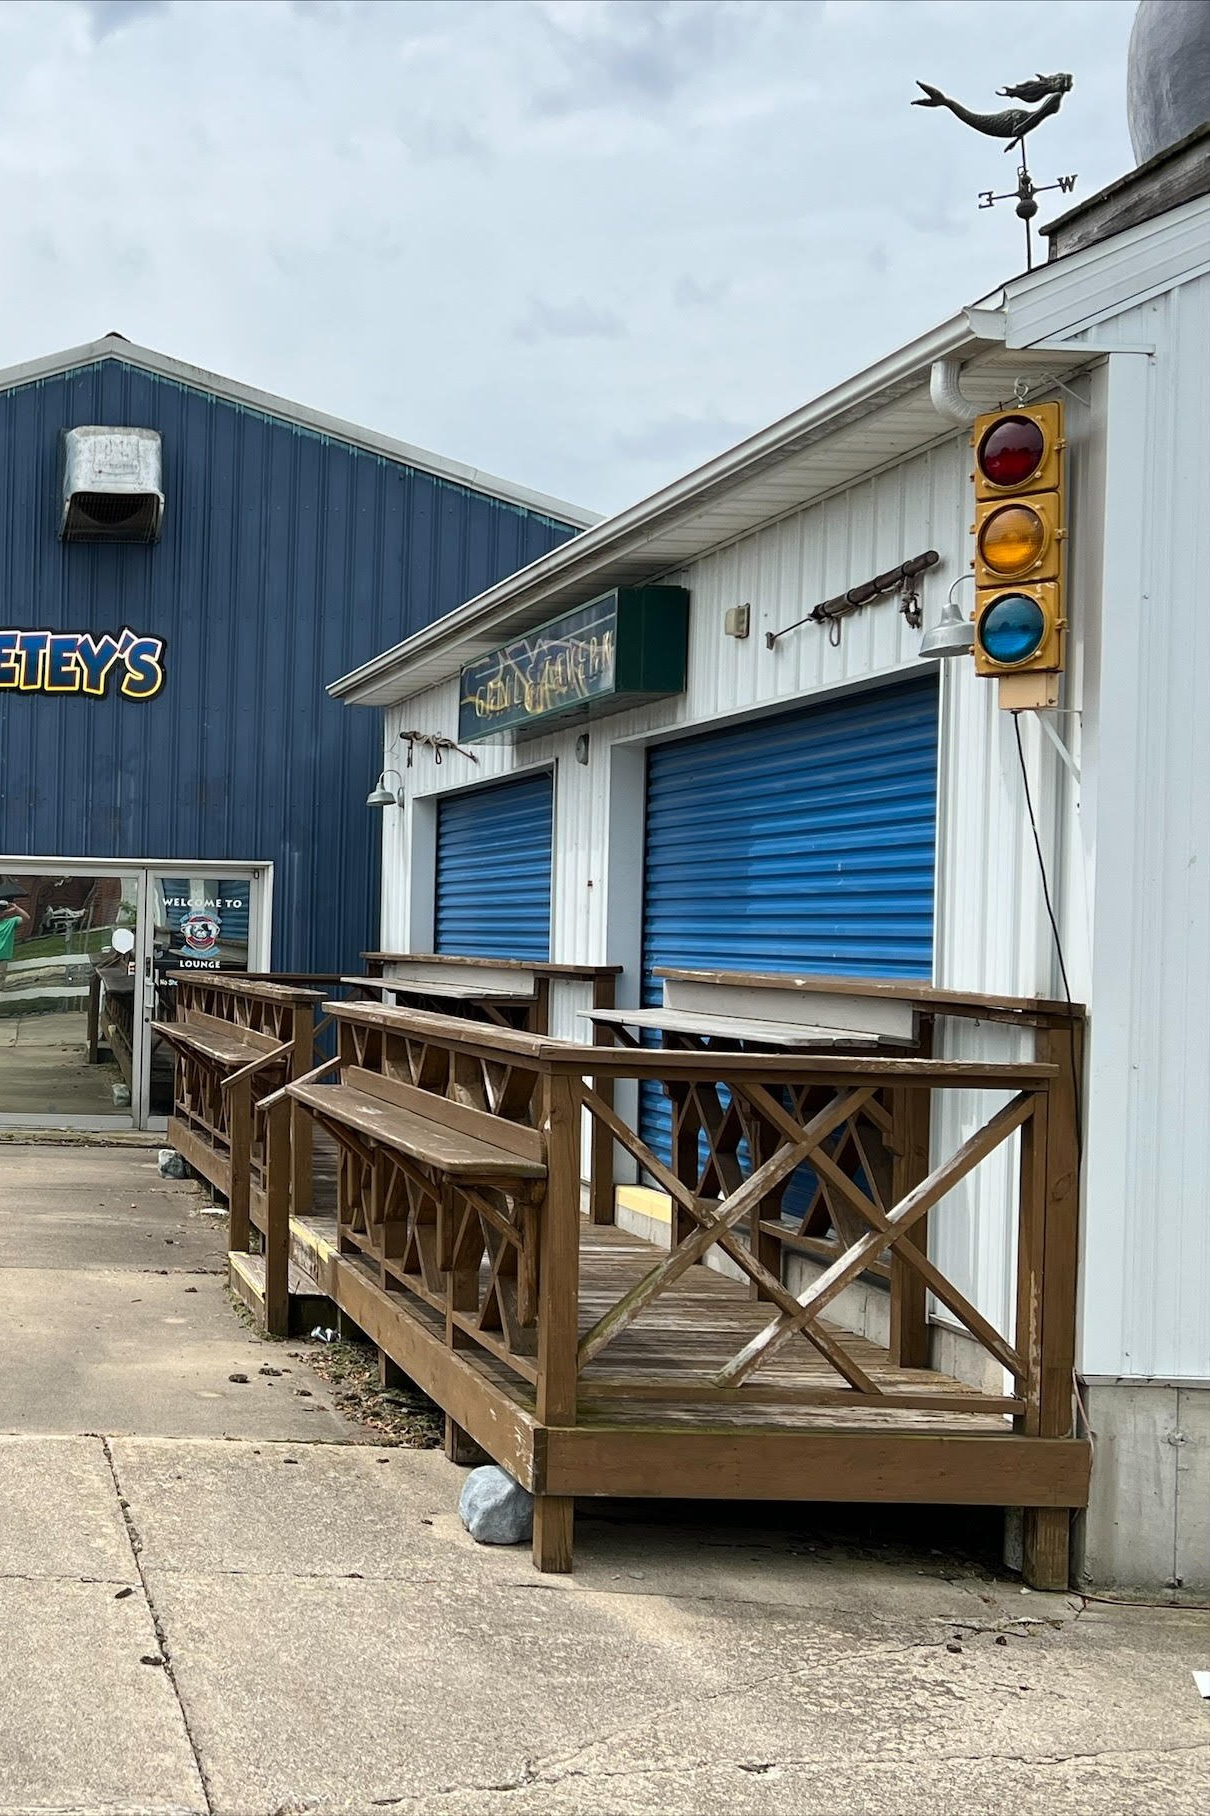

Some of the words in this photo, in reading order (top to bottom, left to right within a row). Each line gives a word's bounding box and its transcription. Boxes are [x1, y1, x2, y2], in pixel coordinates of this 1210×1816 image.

[1057, 174, 1078, 193] W
[162, 898, 222, 908] WELCOME
[225, 899, 243, 909] TO
[179, 960, 221, 969] LOUNGE
